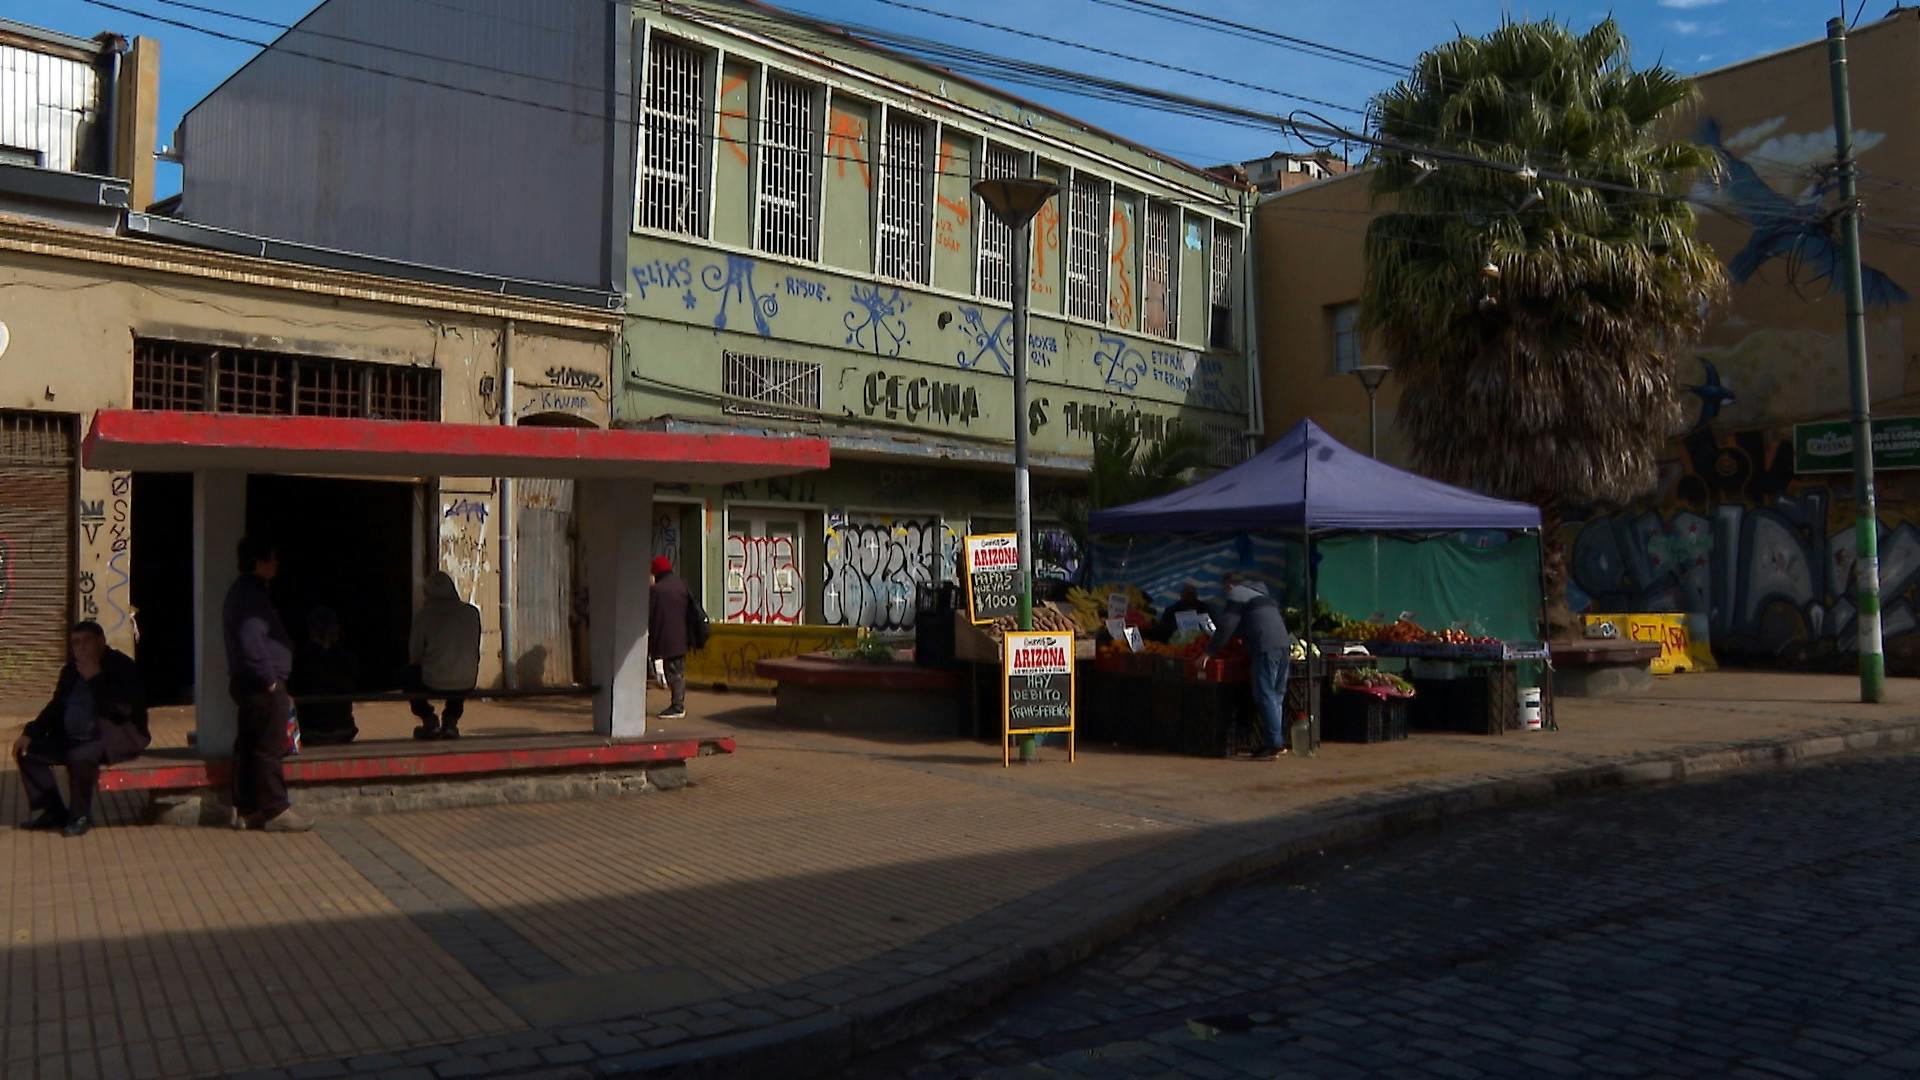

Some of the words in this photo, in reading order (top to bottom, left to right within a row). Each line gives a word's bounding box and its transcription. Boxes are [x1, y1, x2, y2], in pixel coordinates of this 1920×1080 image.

[975, 547, 1018, 566] ARIZONA
[976, 593, 1017, 613] $1000
[1014, 647, 1066, 668] ARIZONA
[1027, 674, 1052, 688] HAY
[1013, 689, 1061, 701] DEBITO
